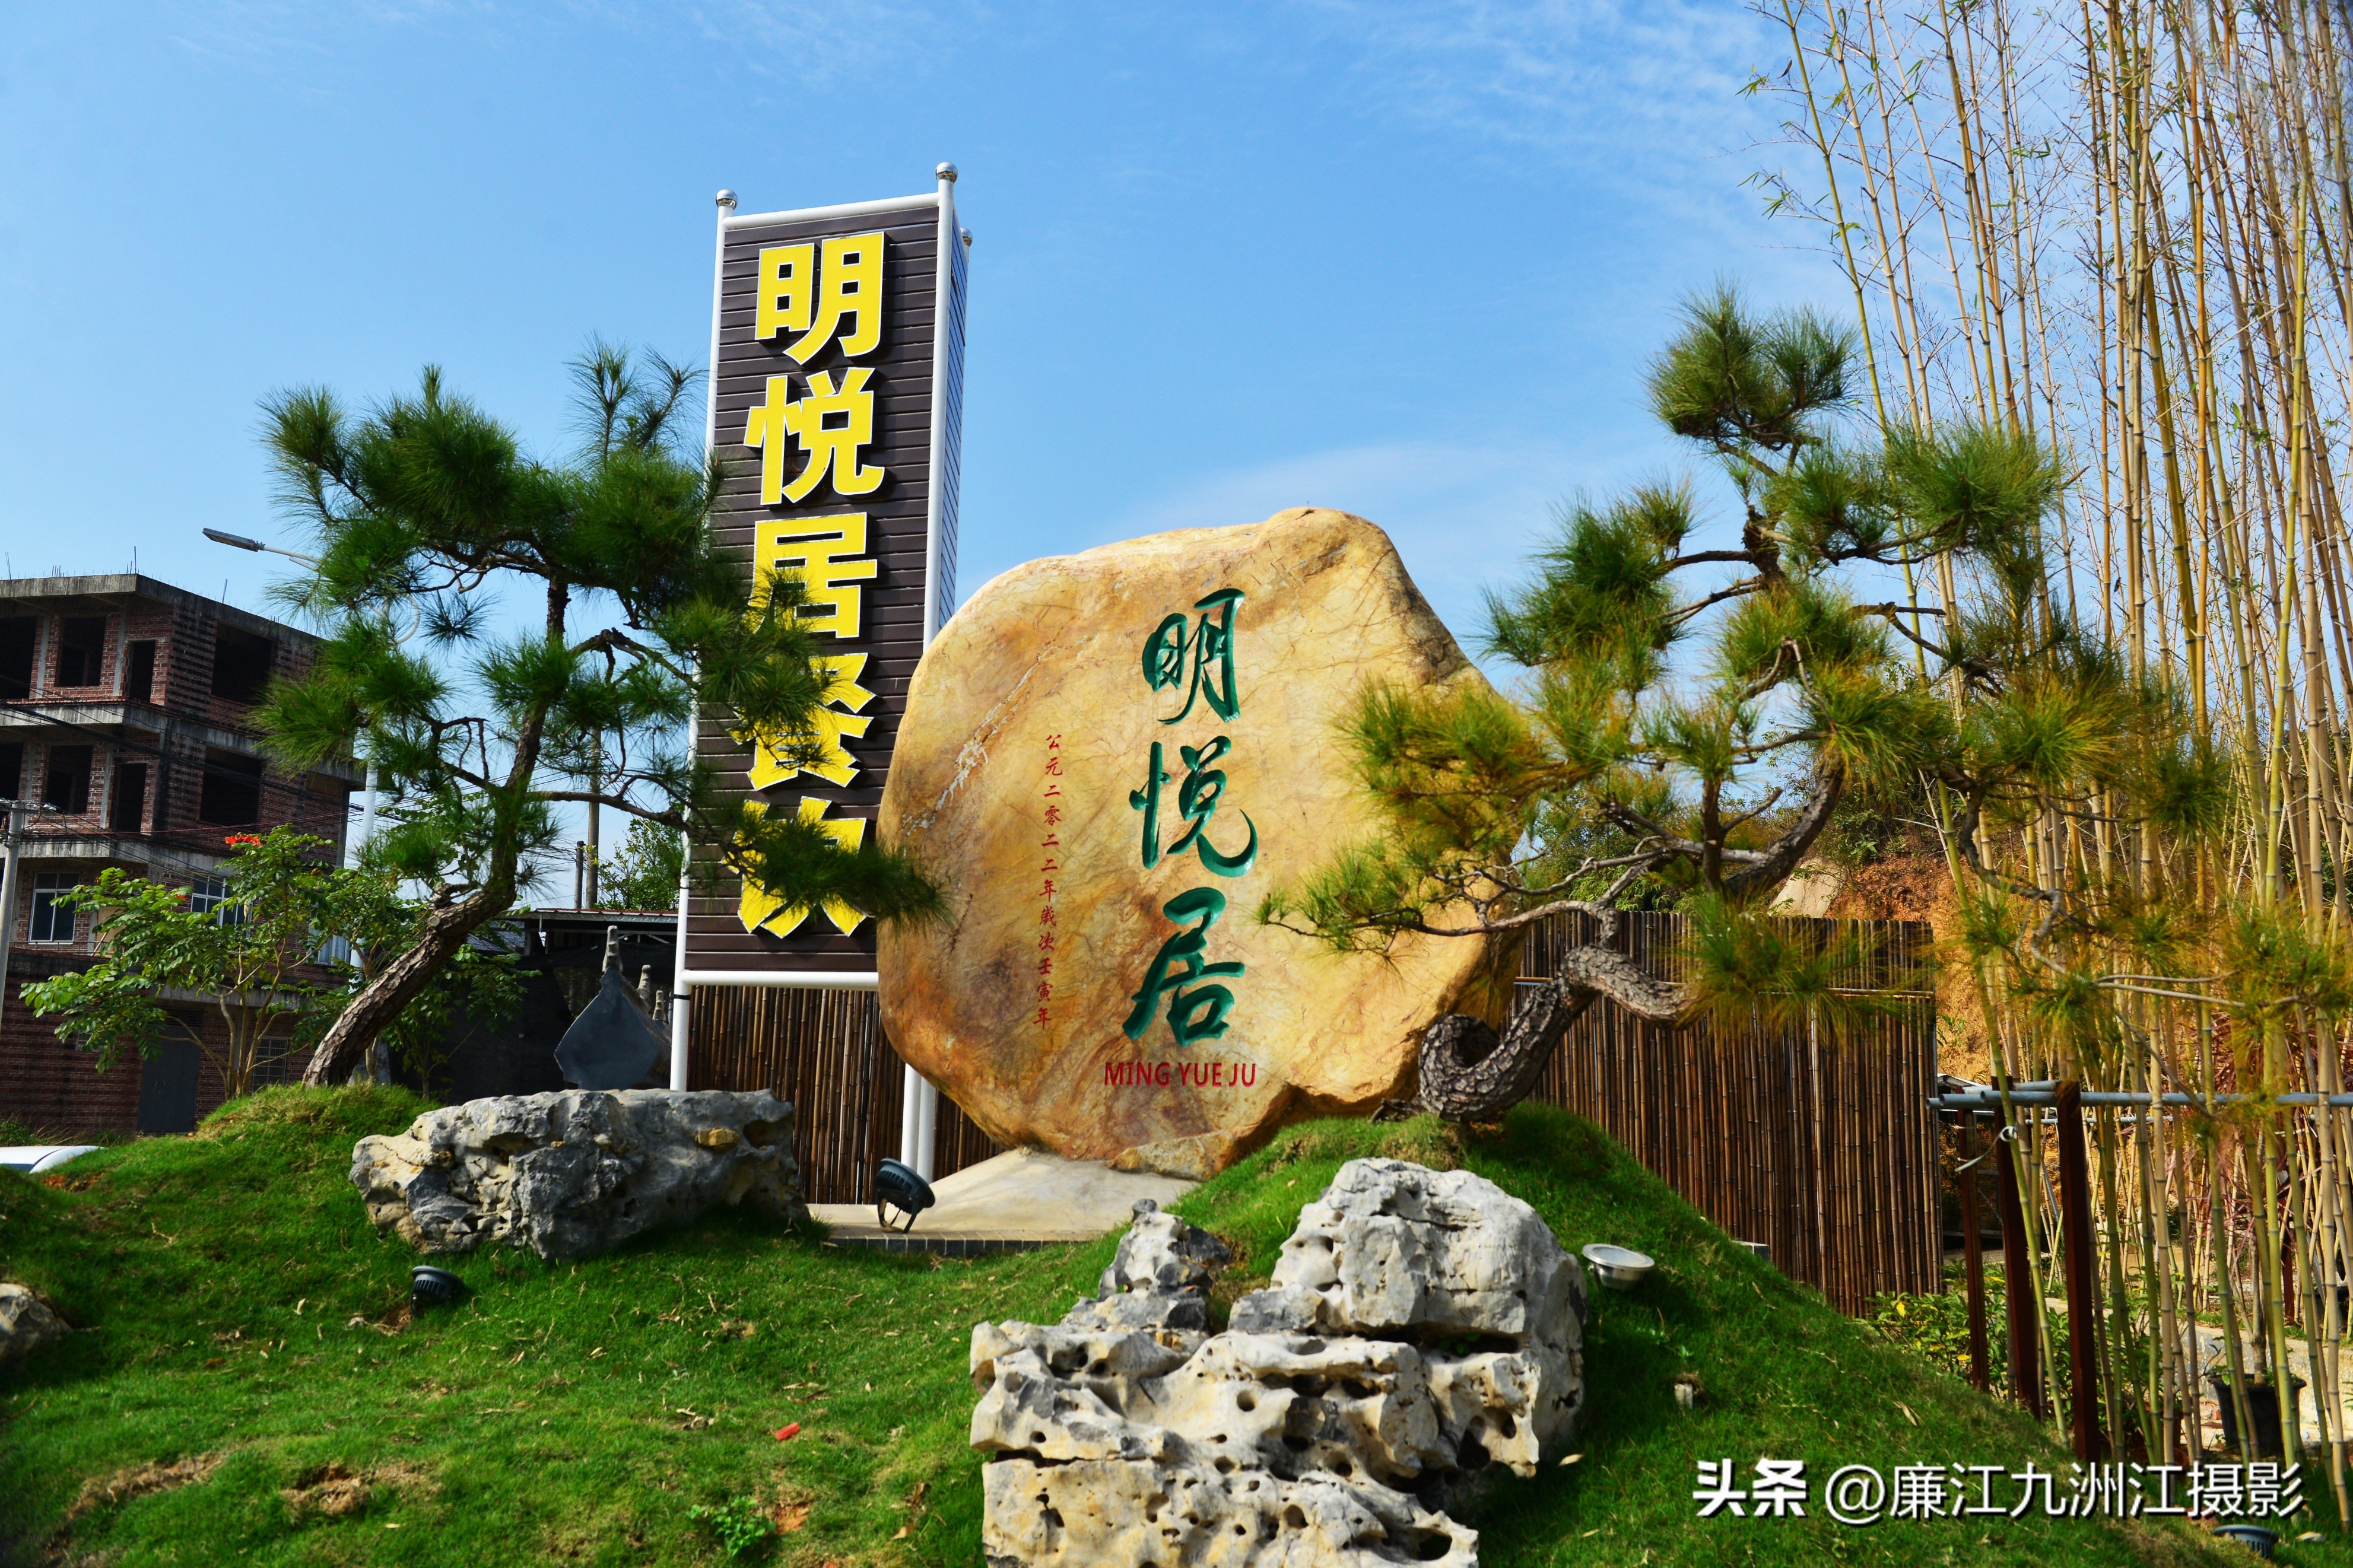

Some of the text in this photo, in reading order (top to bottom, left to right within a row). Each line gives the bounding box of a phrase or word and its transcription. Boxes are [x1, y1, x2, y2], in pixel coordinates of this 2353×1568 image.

[1123, 588, 1259, 1047] 明悦居
[1104, 1062, 1256, 1087] MING YUE JU
